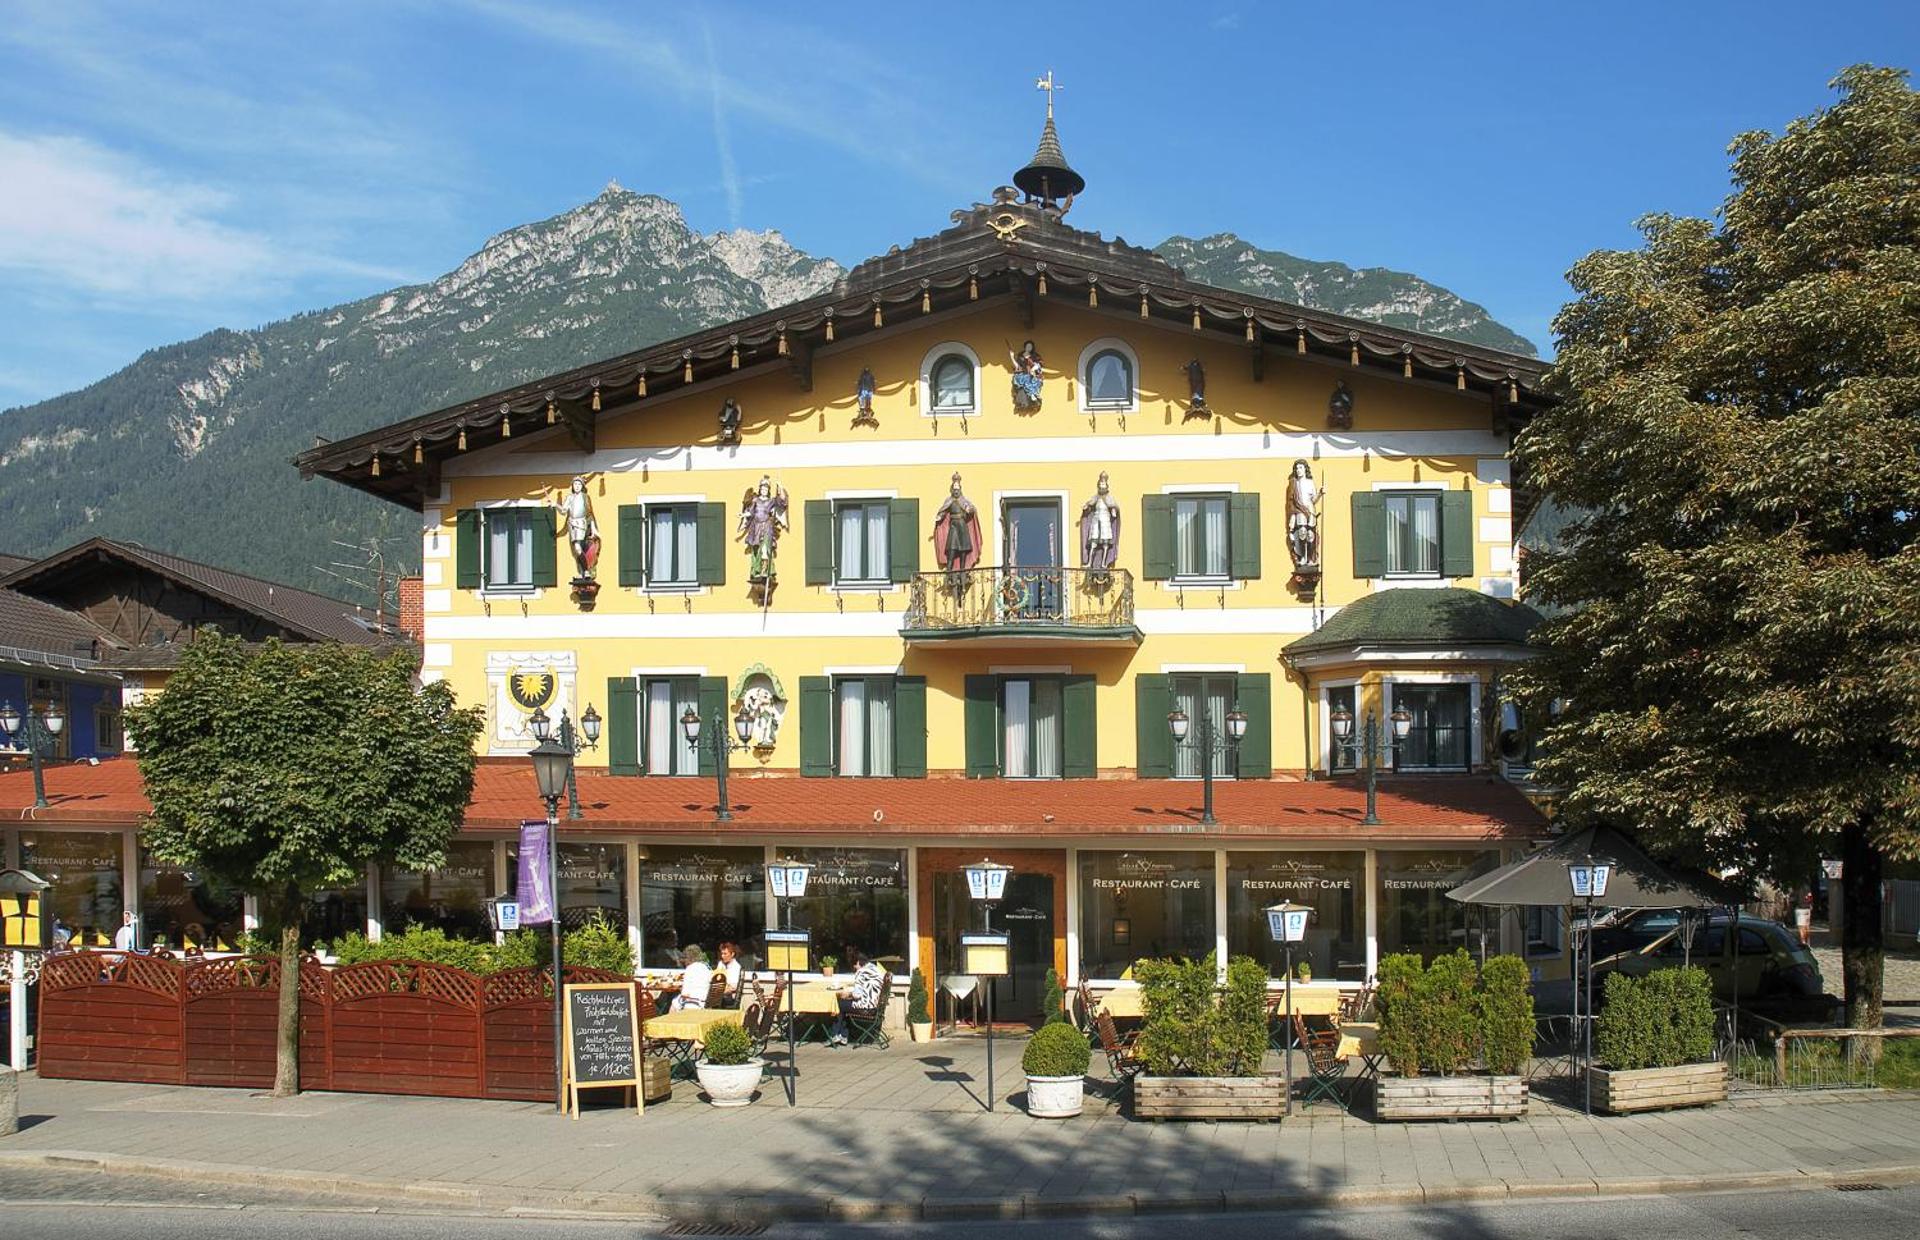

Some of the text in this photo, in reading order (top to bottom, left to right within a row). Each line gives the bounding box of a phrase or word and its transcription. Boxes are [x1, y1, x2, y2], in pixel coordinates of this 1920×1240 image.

[31, 857, 88, 867] RESTAURANT
[653, 872, 753, 883] RESTAURANT CAFÉ
[864, 874, 895, 886] CAFÉ
[1093, 878, 1201, 890] RESTAURANT CAFÉ
[1242, 878, 1351, 890] RESTAURANT CAFÉ
